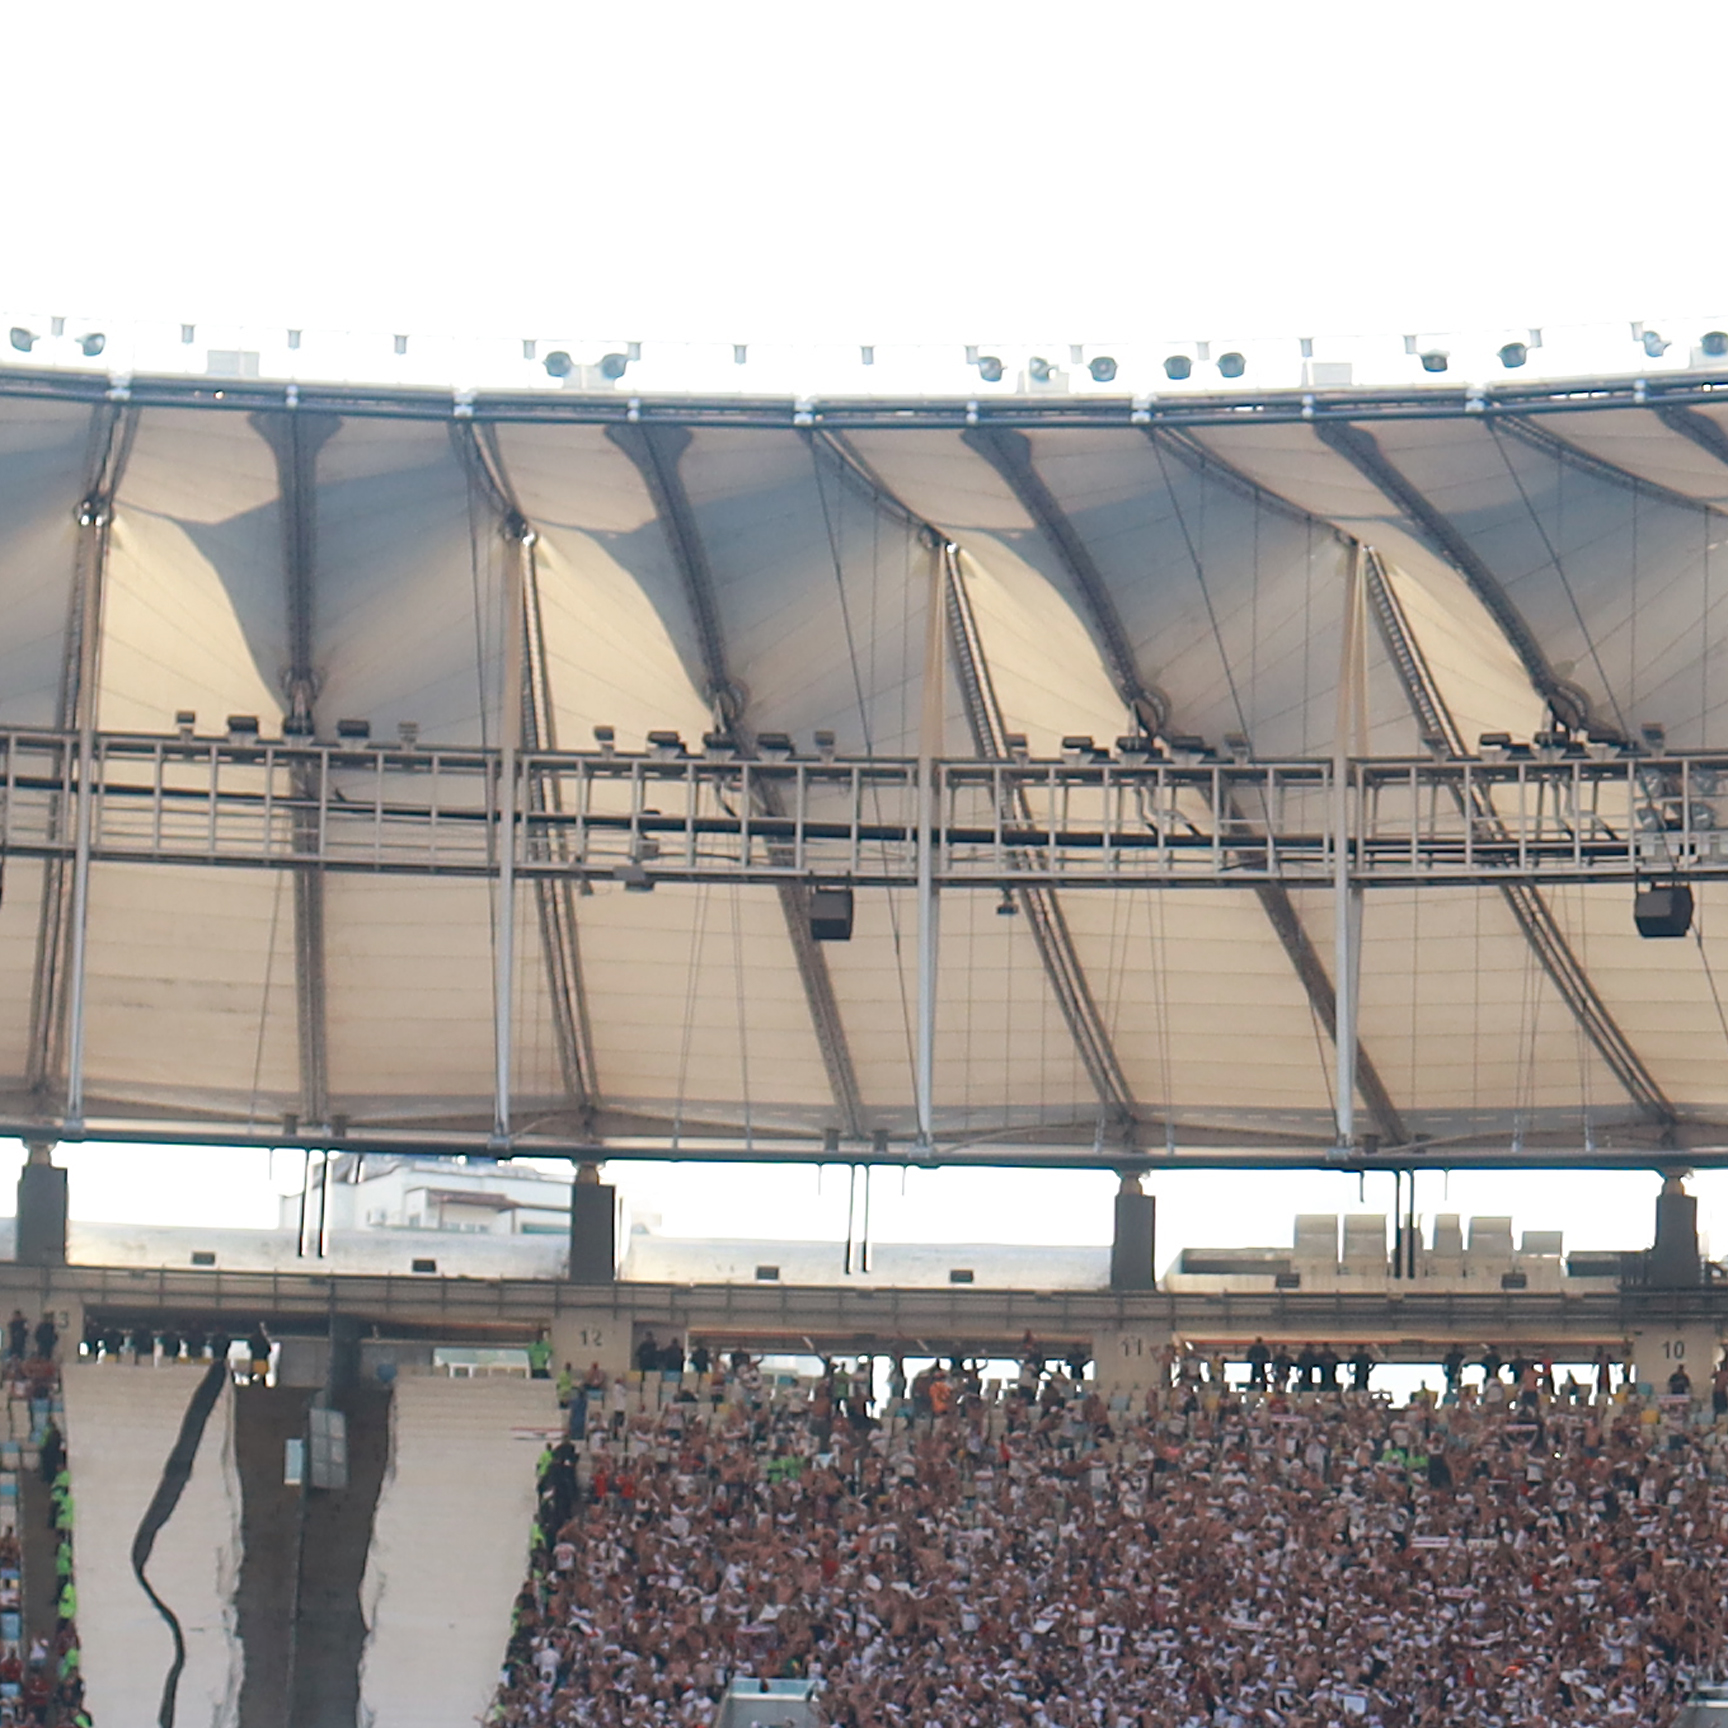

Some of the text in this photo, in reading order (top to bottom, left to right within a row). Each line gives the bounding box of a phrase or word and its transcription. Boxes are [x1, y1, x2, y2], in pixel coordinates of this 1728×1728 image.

[581, 1329, 602, 1347] 12
[1122, 1338, 1142, 1357] 11
[1662, 1341, 1685, 1359] 10
